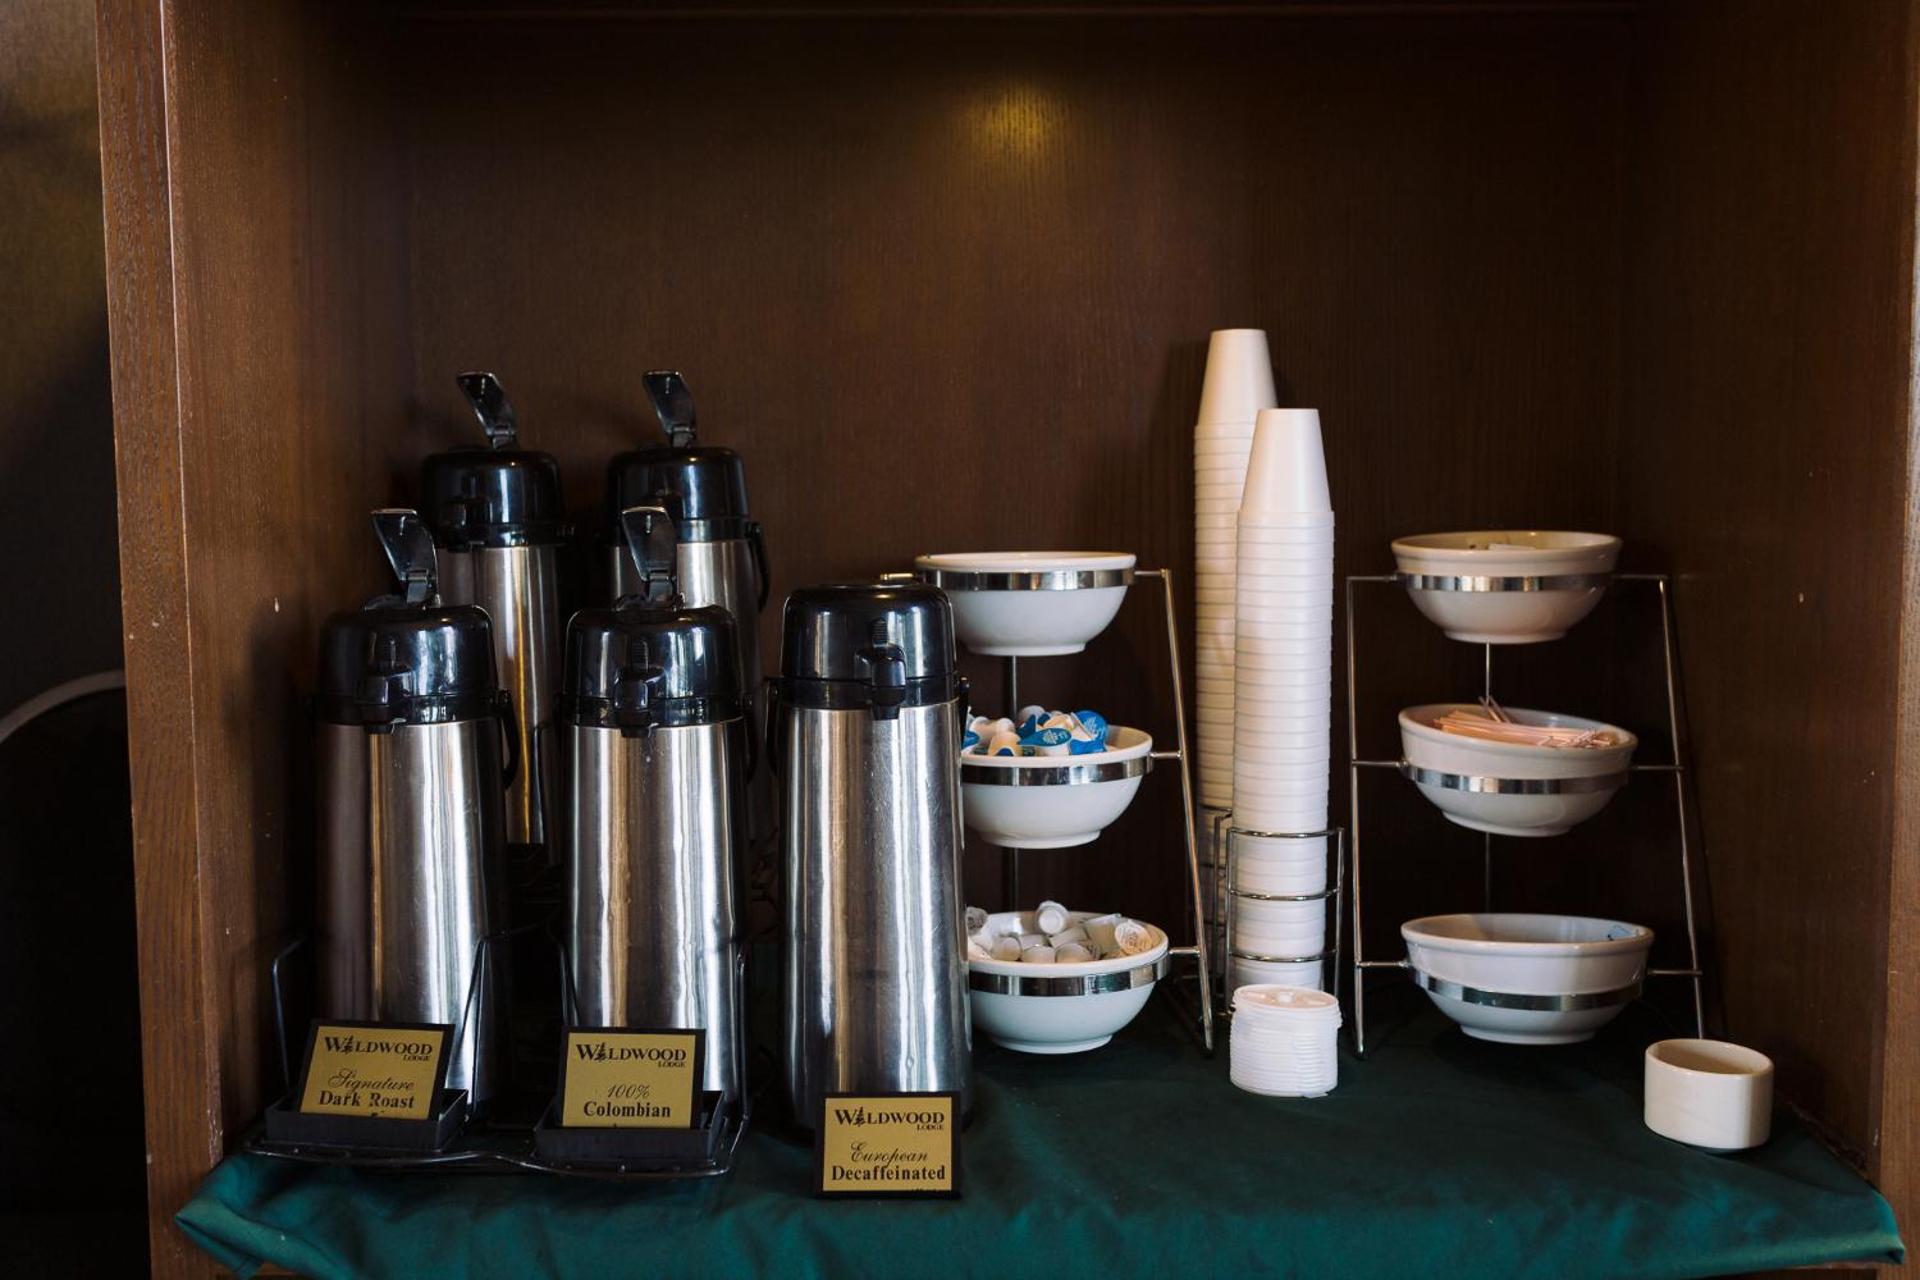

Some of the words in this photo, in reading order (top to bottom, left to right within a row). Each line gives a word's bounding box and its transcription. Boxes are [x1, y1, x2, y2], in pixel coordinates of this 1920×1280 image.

[328, 1068, 415, 1093] Signature
[319, 1090, 361, 1107] Dark
[369, 1093, 415, 1109] Roast
[607, 1084, 650, 1099] 100%
[583, 1101, 671, 1118] Colombian
[850, 1141, 929, 1168] European
[832, 1165, 946, 1181] Decaffeinated
